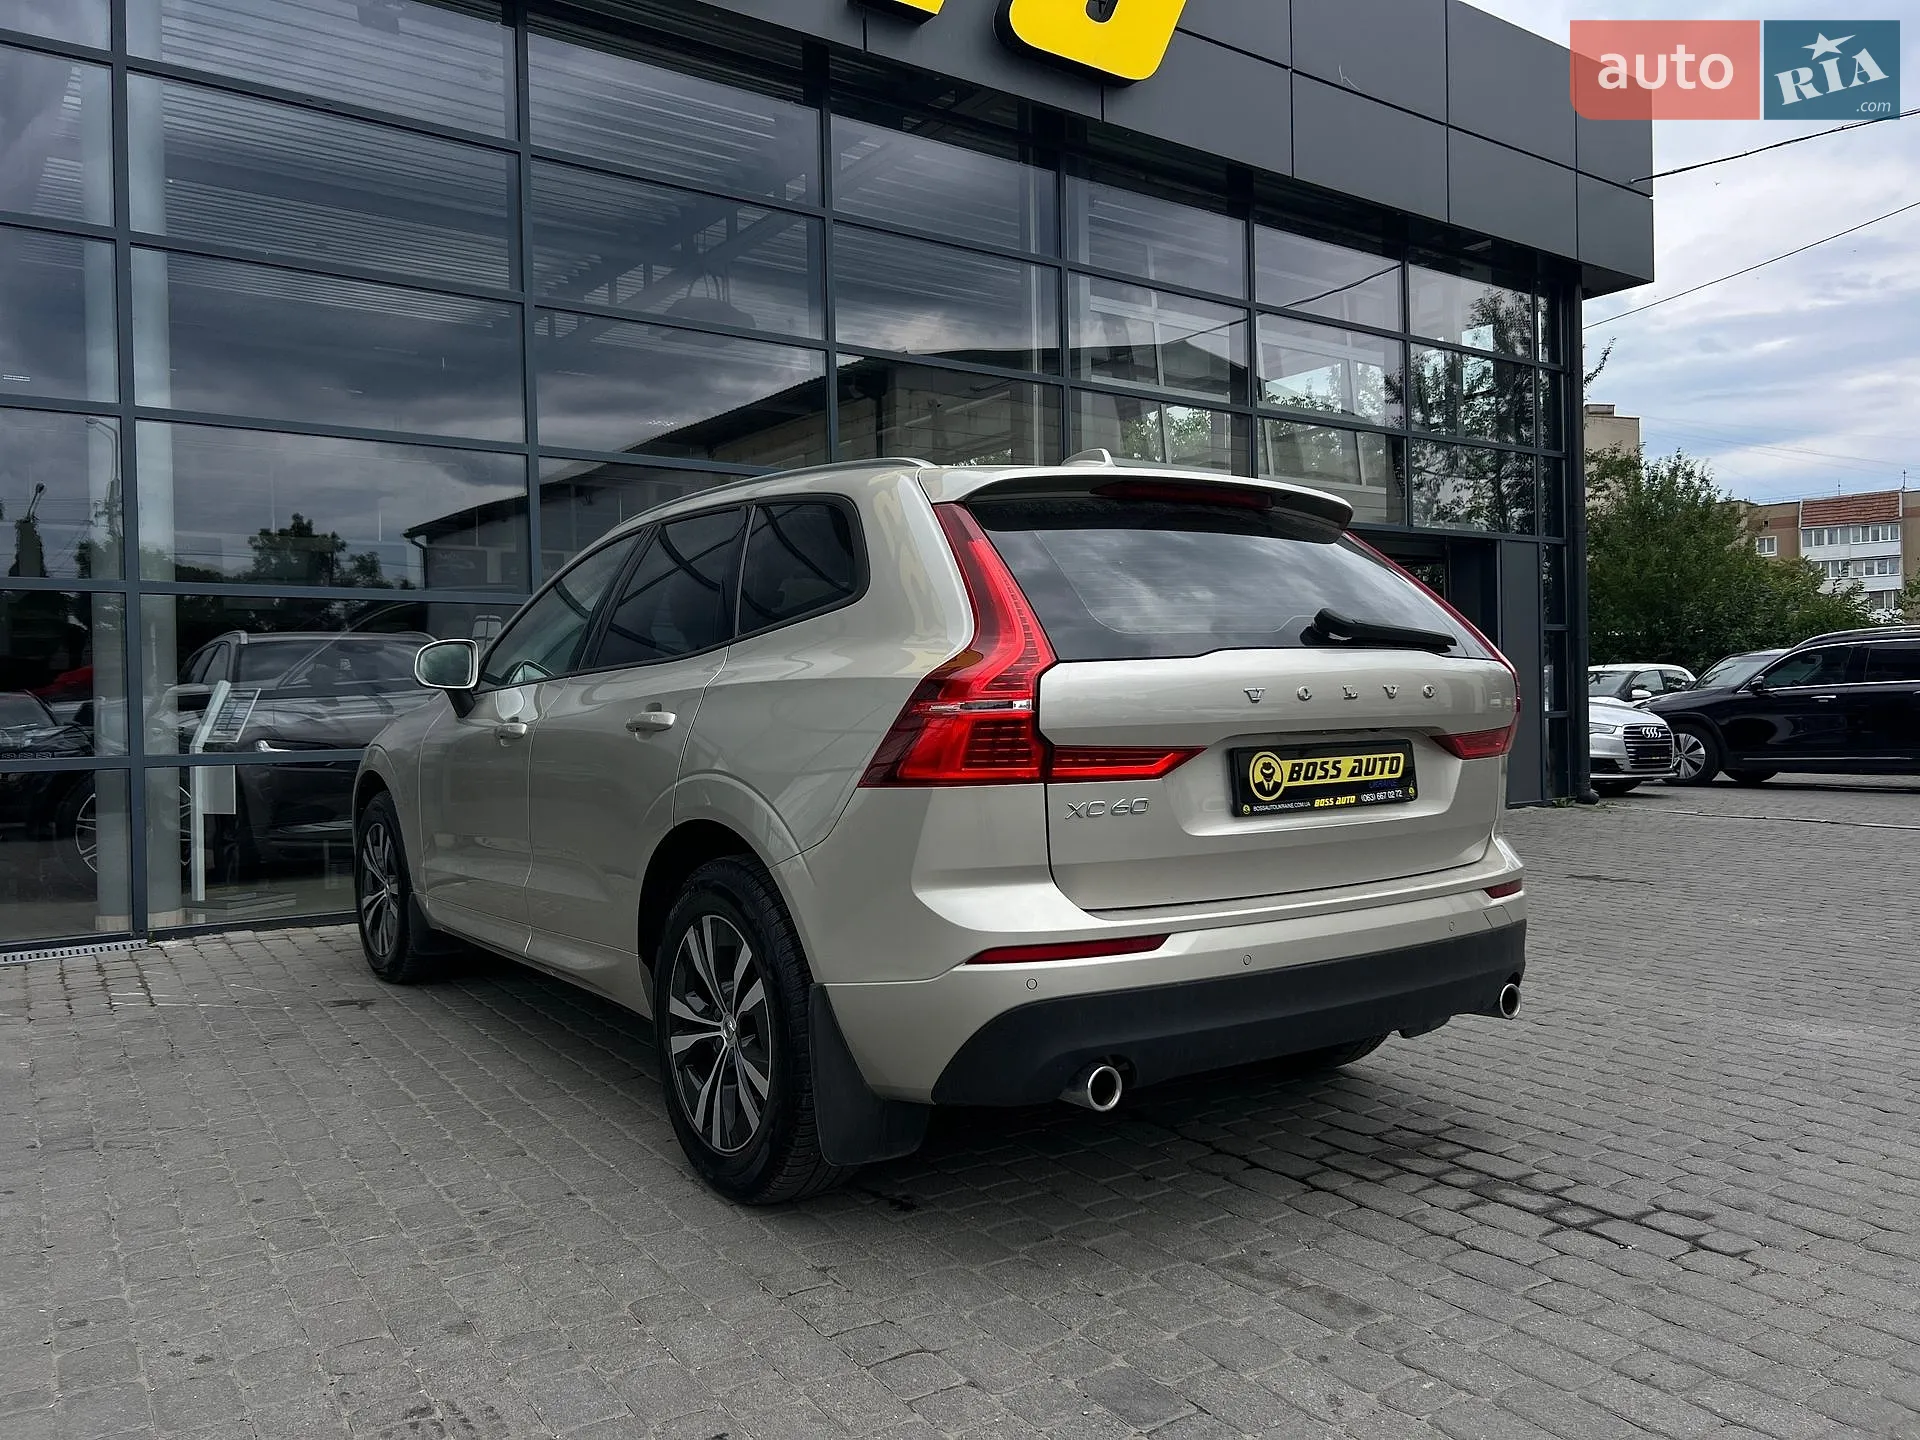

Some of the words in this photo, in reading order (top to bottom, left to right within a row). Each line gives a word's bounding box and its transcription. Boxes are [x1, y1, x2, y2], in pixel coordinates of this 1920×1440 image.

[1242, 684, 1440, 704] VOLVO
[1287, 760, 1342, 782] BOSS
[1347, 756, 1403, 778] AUTO
[1314, 797, 1334, 807] BOSS
[1335, 796, 1356, 805] AUTO
